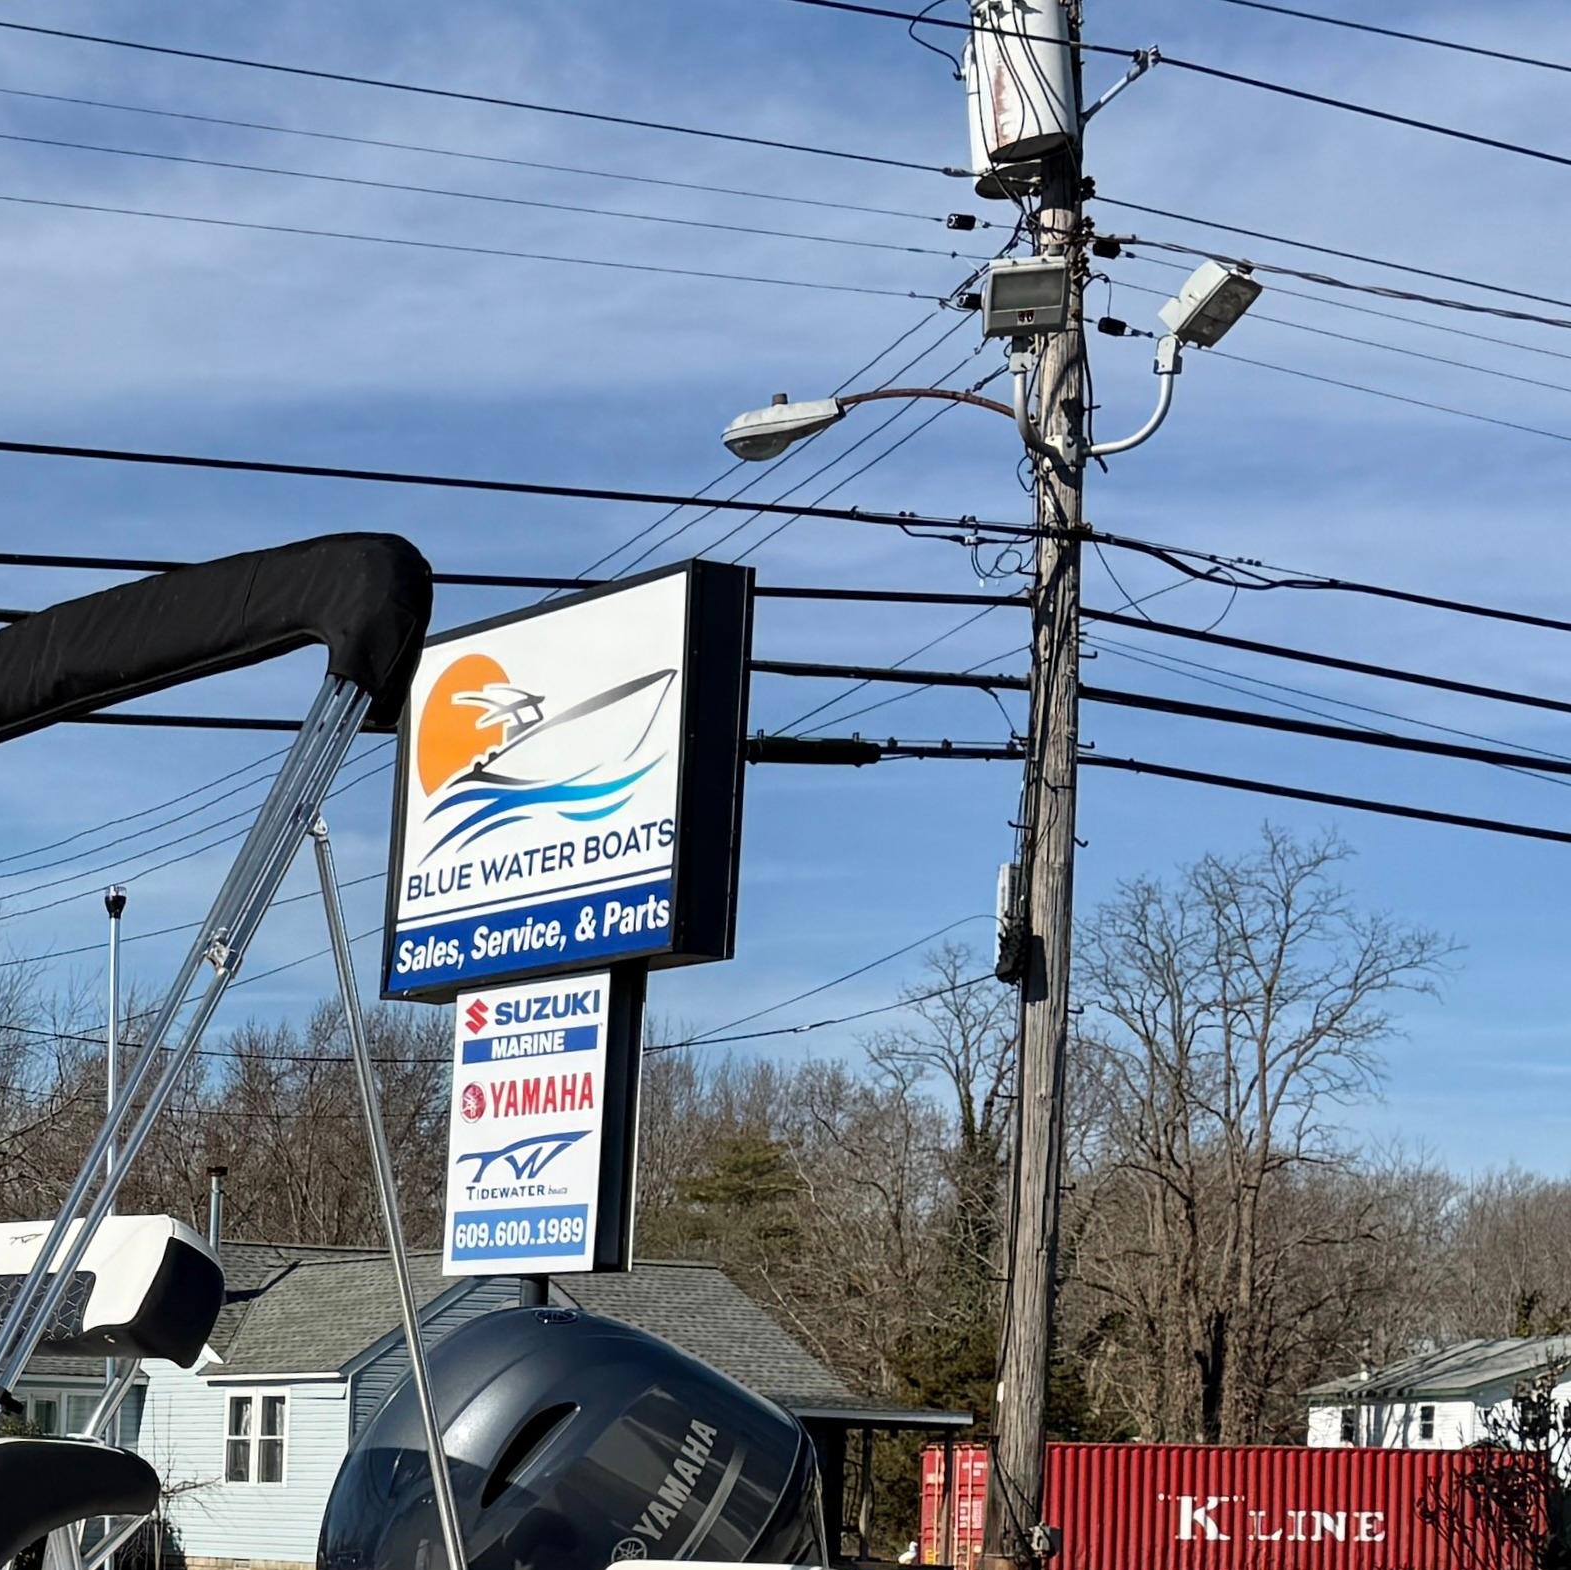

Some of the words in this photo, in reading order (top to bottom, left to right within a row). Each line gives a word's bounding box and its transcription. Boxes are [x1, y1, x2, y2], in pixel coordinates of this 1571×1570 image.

[407, 862, 473, 901] BLUE
[480, 841, 575, 886] WATER
[583, 818, 676, 864] BOATS
[396, 936, 465, 974] Sales,
[470, 917, 567, 960] Service,
[575, 905, 597, 942] &
[602, 894, 670, 937] Parts
[495, 989, 601, 1026] SUZUKI
[491, 1030, 566, 1060] MARINE
[491, 1072, 594, 1118] YAMAHA
[455, 1216, 584, 1249] 609.600.1989
[632, 1418, 718, 1541] YAMAHA
[1248, 1510, 1386, 1542] LINE
